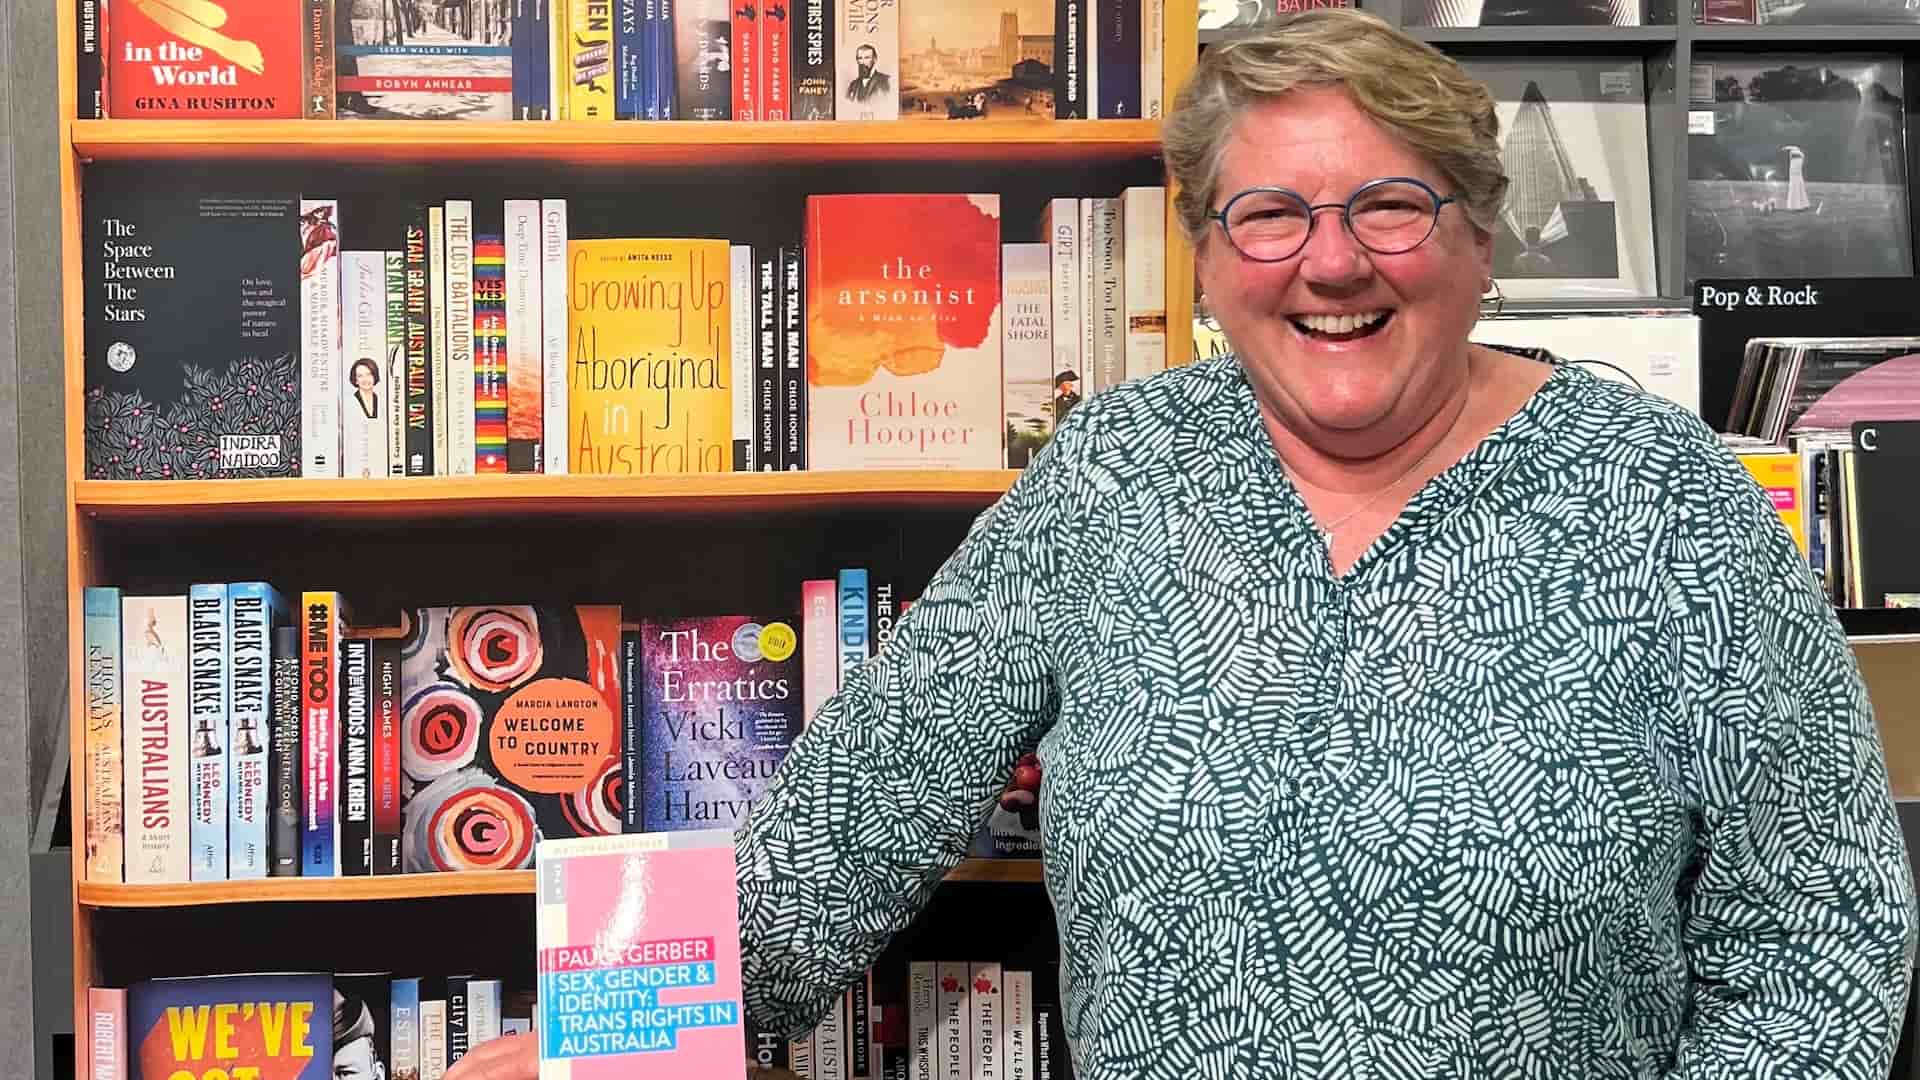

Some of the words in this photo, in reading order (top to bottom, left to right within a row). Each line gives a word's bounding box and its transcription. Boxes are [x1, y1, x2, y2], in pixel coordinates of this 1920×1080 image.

[124, 41, 152, 62] in
[158, 41, 203, 62] the
[807, 32, 822, 65] SPIES
[151, 64, 238, 86] World
[375, 79, 418, 89] ROBYN
[424, 79, 473, 89] ANNEAR
[135, 97, 179, 110] GINA
[187, 97, 275, 110] RUSHTON
[102, 218, 136, 236] The
[449, 215, 469, 242] THE
[1103, 208, 1117, 234] Too
[103, 240, 152, 262] Space
[407, 228, 425, 264] STAN
[449, 245, 469, 277] LOST
[104, 261, 175, 279] Between
[387, 256, 404, 298] STAN
[477, 279, 502, 289] YES
[761, 262, 773, 290] THE
[786, 262, 799, 290] THE
[881, 256, 932, 280] the
[103, 282, 137, 300] The
[407, 269, 425, 314] GRANT
[477, 289, 502, 299] YES
[573, 249, 684, 348] Growing
[688, 249, 725, 346] Up
[838, 283, 976, 305] arsonist
[1103, 277, 1117, 306] Too
[1701, 286, 1740, 310] Pop
[1746, 287, 1763, 306] &
[1767, 285, 1818, 306] Rock
[104, 303, 145, 321] Stars
[387, 300, 404, 347] GRANT
[449, 281, 469, 361] BATTALIONS
[761, 292, 773, 329] TALL
[786, 292, 799, 329] TALL
[1010, 316, 1048, 327] FATAL
[1016, 303, 1041, 314] THE
[1103, 307, 1117, 339] Late
[761, 331, 773, 369] MAN
[786, 331, 799, 369] MAN
[1007, 328, 1049, 340] SHORE
[407, 322, 425, 397] AUSTRALIA
[573, 324, 729, 430] Aboriginal
[407, 403, 425, 429] DAY
[603, 400, 630, 434] in
[860, 391, 958, 417] Chloe
[221, 437, 278, 450] INDIRA
[577, 411, 724, 474] Australia
[847, 417, 975, 453] Hooper
[1859, 429, 1878, 451] C
[221, 452, 279, 467] NAIDOO
[877, 584, 892, 616] THE
[193, 598, 221, 655] BLACK
[234, 597, 262, 653] BLACK
[308, 603, 328, 653] #ME
[348, 643, 365, 675] INTO
[660, 628, 729, 662] The
[89, 644, 103, 734] KENEALLY
[101, 655, 114, 730] THOMAS
[193, 657, 221, 715] SNAKE
[234, 655, 262, 713] SNAKE
[290, 658, 299, 702] BEYOND
[308, 656, 328, 703] TOO
[382, 661, 392, 697] NIGHT
[661, 669, 789, 702] Erratics
[348, 686, 365, 736] WOODS
[382, 700, 392, 738] GAMES
[515, 699, 552, 709] MARCIA
[555, 699, 598, 709] LANGTON
[290, 704, 299, 744] WORDS
[504, 718, 585, 732] WELCOME
[660, 708, 745, 741] Vicki
[141, 680, 169, 829] AUSTRALIANS
[348, 737, 365, 776] ANNA
[497, 735, 518, 750] TO
[525, 741, 600, 756] COUNTRY
[202, 761, 212, 825] KENNEDY
[243, 760, 253, 824] KENNEDY
[348, 778, 365, 821] KRIEN
[627, 940, 709, 964] GERBER
[558, 970, 603, 994] SEX,
[604, 965, 691, 989] GENDER
[696, 964, 712, 983] &
[449, 994, 465, 1028] city
[558, 990, 653, 1014] IDENTITY:
[948, 1000, 959, 1025] THE
[981, 1001, 992, 1027] THE
[166, 1001, 314, 1062] WE'VE
[558, 1010, 627, 1033] TRANS
[631, 1005, 705, 1028] RIGHTS
[710, 1004, 732, 1023] IN
[558, 1029, 673, 1056] AUSTRALIA
[918, 1026, 930, 1047] THIS
[948, 1027, 959, 1077] PEOPLE
[981, 1028, 992, 1077] PEOPLE
